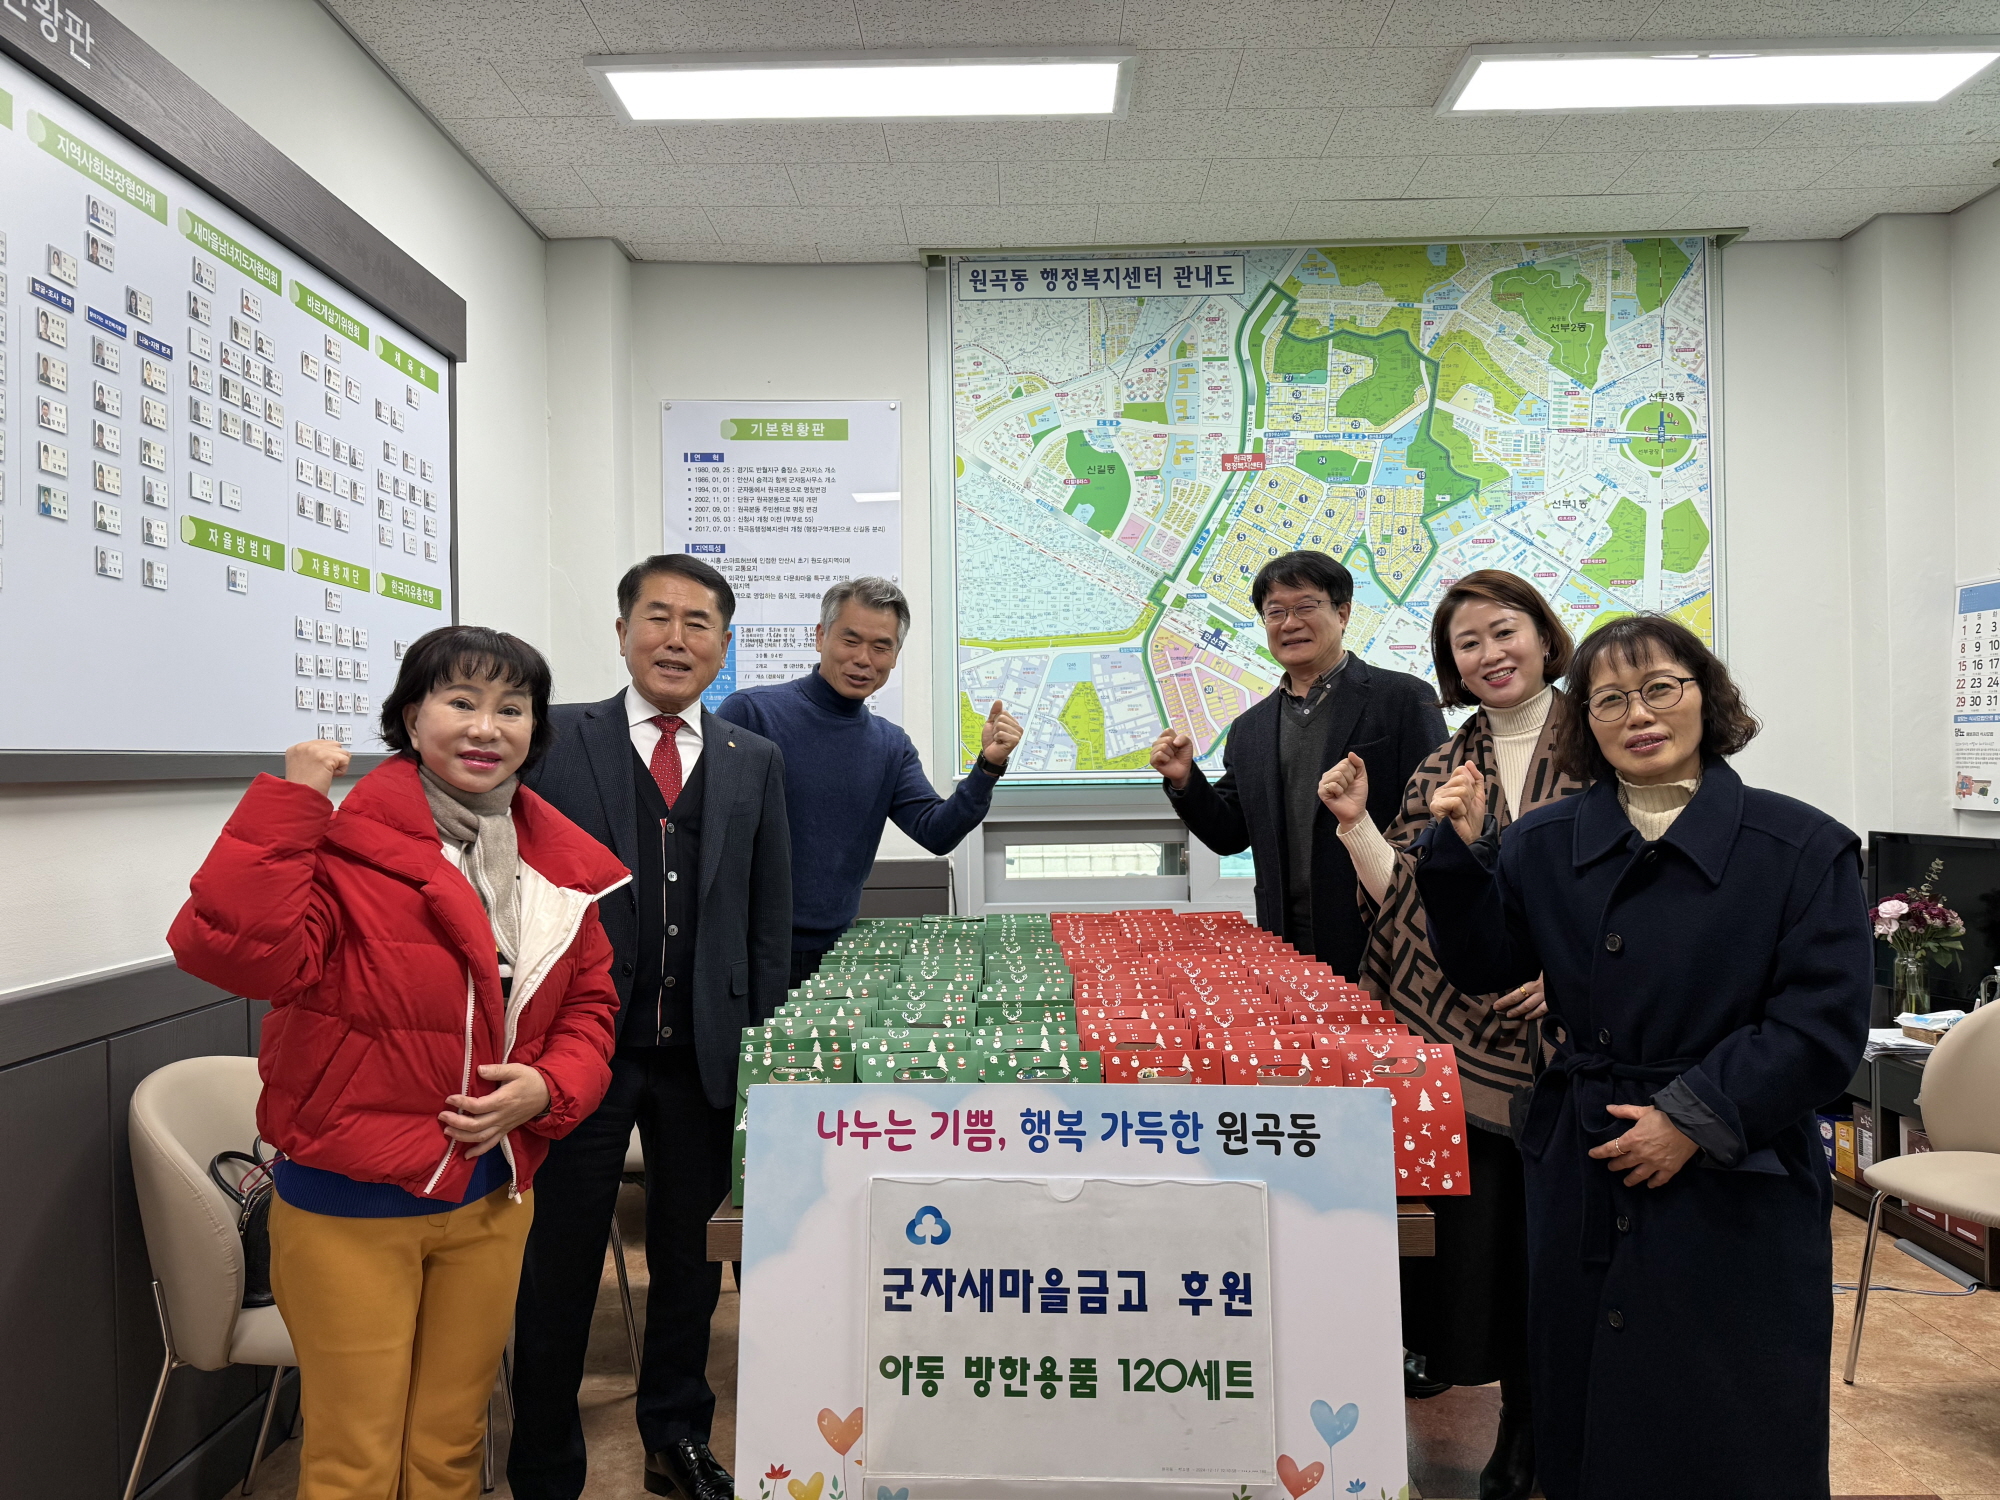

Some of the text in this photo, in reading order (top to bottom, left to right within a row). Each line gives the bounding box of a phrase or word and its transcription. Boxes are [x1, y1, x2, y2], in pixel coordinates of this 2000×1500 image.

[57, 134, 156, 213] 지역사회보장협의체
[193, 221, 278, 289] 새마을남녀지도자협의회
[968, 264, 1235, 293] 원곡동 행정복지센터 관내도
[61, 294, 72, 308] 분과
[307, 294, 360, 341] 바르게살기위원회
[1550, 322, 1587, 333] 선부2동
[161, 342, 172, 356] 분과
[1649, 392, 1685, 402] 선부3동
[750, 422, 825, 437] 기본현황판
[1086, 465, 1116, 475] 신길동
[1552, 499, 1588, 509] 선부1동
[209, 528, 271, 561] 자율방범대
[695, 545, 722, 553] 지역특성
[312, 557, 360, 585] 자율방재단
[391, 580, 434, 604] 한국자유총연맹
[1962, 621, 1997, 635] 1 2 3
[1203, 631, 1226, 651] 안산역
[1960, 639, 2000, 653] 8 9 10
[1958, 657, 2000, 671] 15 16 17
[1956, 676, 2000, 689] 22 23 24
[1956, 694, 1998, 707] 29 30 31
[816, 1107, 1321, 1158] 나누는 기쁨, 행복 가득한 원곡동
[882, 1266, 1254, 1317] 군자새마을금고 후원
[878, 1354, 1255, 1401] 아동 방한용품 120세트
